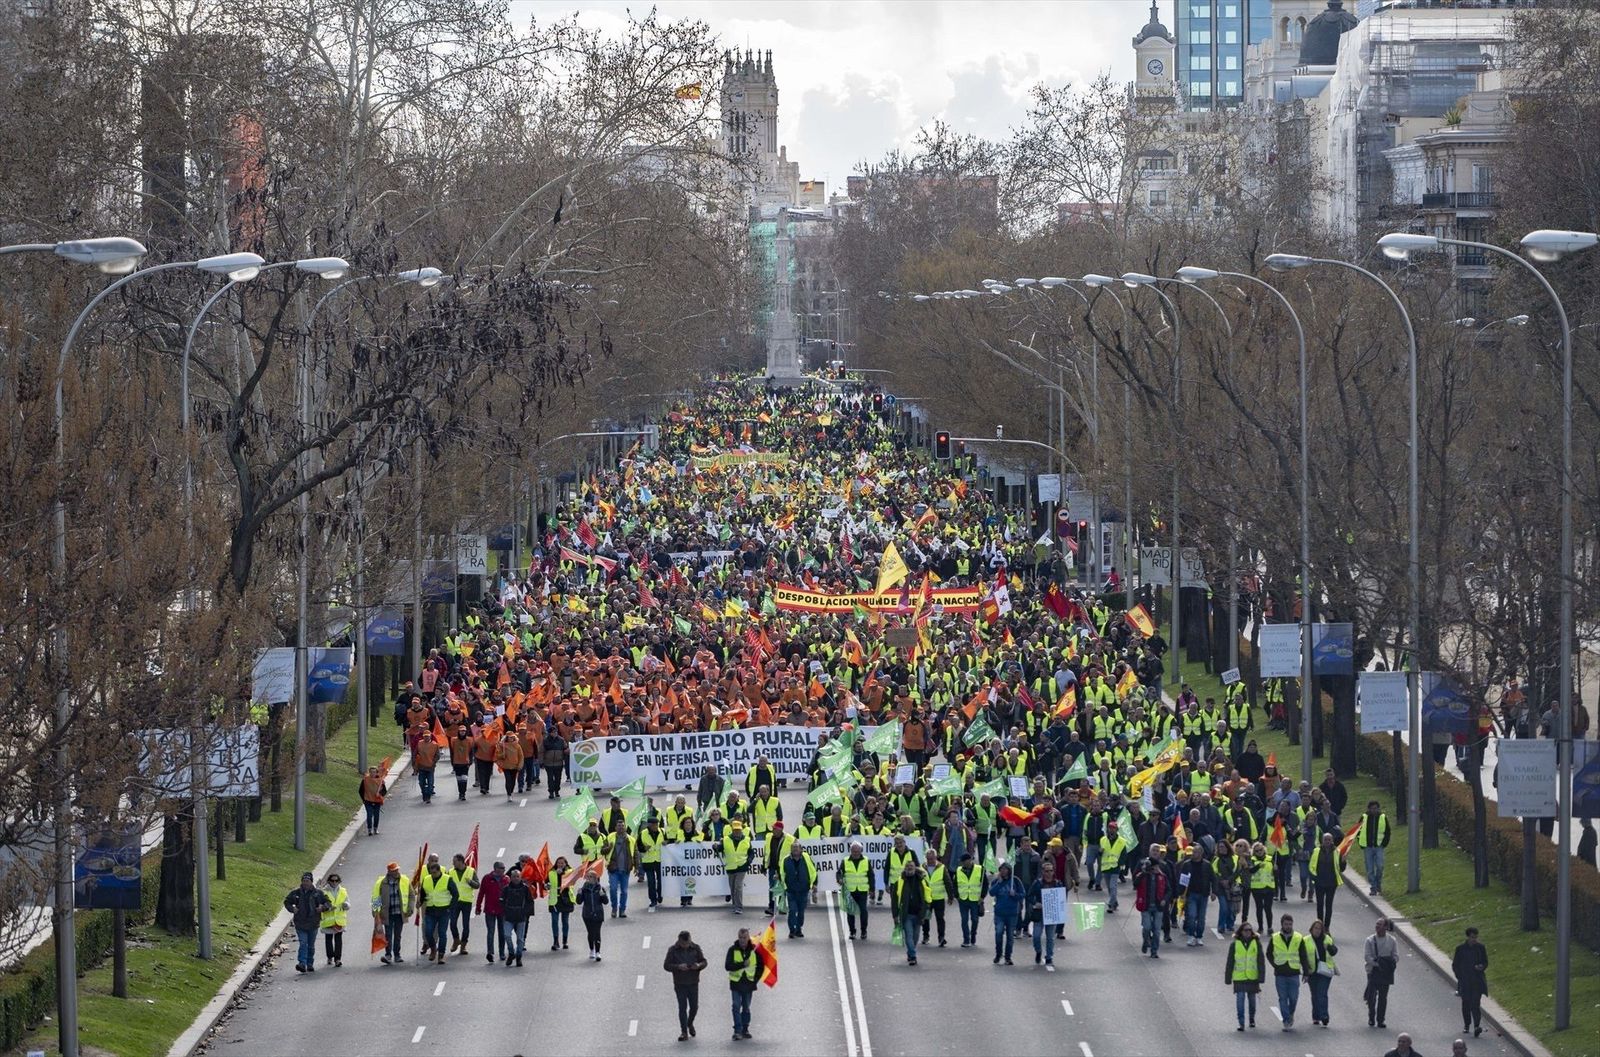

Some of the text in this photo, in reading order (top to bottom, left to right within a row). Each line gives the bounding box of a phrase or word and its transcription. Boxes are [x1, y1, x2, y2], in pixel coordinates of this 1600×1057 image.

[1142, 550, 1170, 559] MAD
[470, 558, 485, 567] RA
[1152, 559, 1170, 568] RID
[1185, 560, 1201, 570] TU
[778, 591, 858, 606] DESPOBLACION
[943, 596, 979, 606] NACION
[605, 738, 645, 753] POR
[649, 737, 674, 751] UN
[681, 732, 746, 750] MEDIO
[753, 731, 817, 745] RURAL
[636, 746, 814, 766] EN DEFENSA DE LA AGRICULT
[572, 770, 602, 783] UPA
[662, 769, 670, 781] Y
[674, 761, 747, 780] GANAERÍA
[801, 842, 845, 856] GOBIERNO
[865, 842, 895, 853] IGNOR
[684, 848, 719, 860] EUROPA
[704, 864, 726, 876] JUST
[814, 860, 834, 872] ARA
